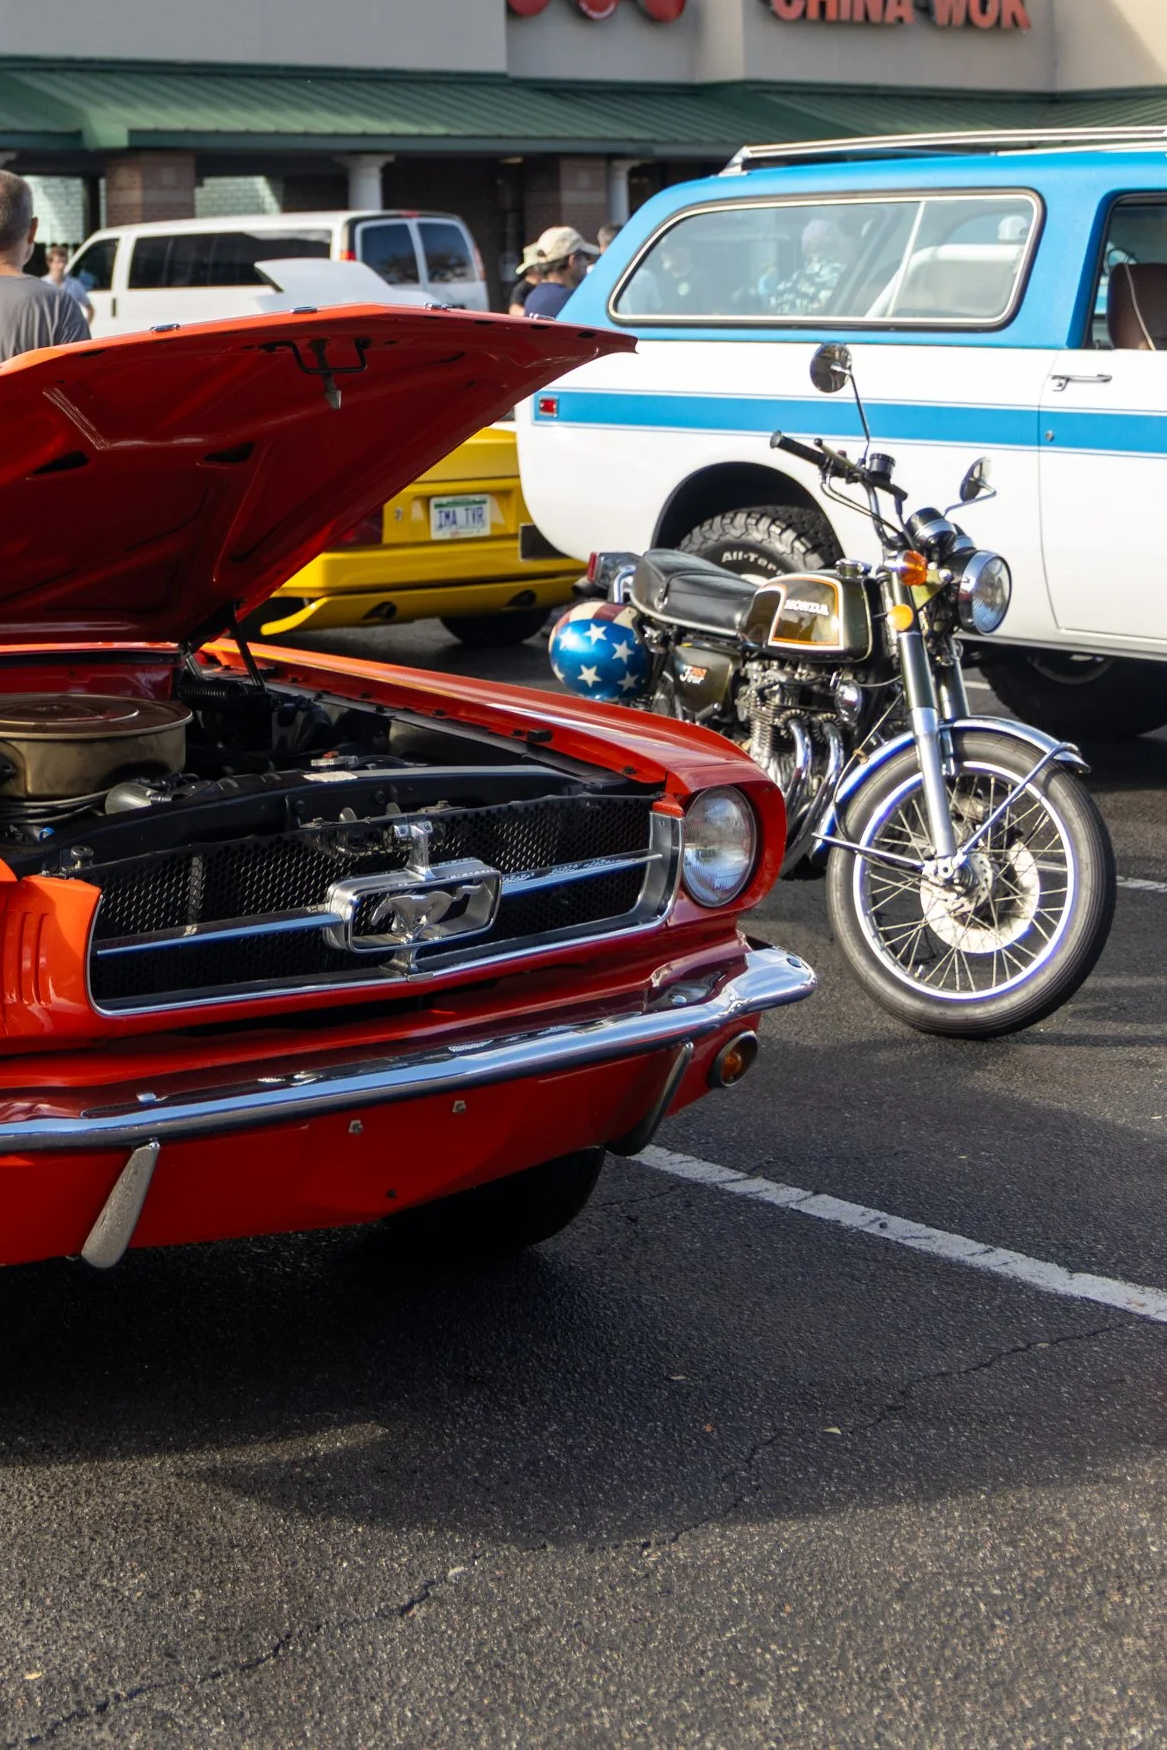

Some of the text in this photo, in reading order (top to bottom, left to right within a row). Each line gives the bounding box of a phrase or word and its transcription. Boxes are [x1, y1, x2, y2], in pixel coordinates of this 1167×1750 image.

[437, 506, 485, 529] IMA TVR
[784, 599, 829, 617] HONDA
